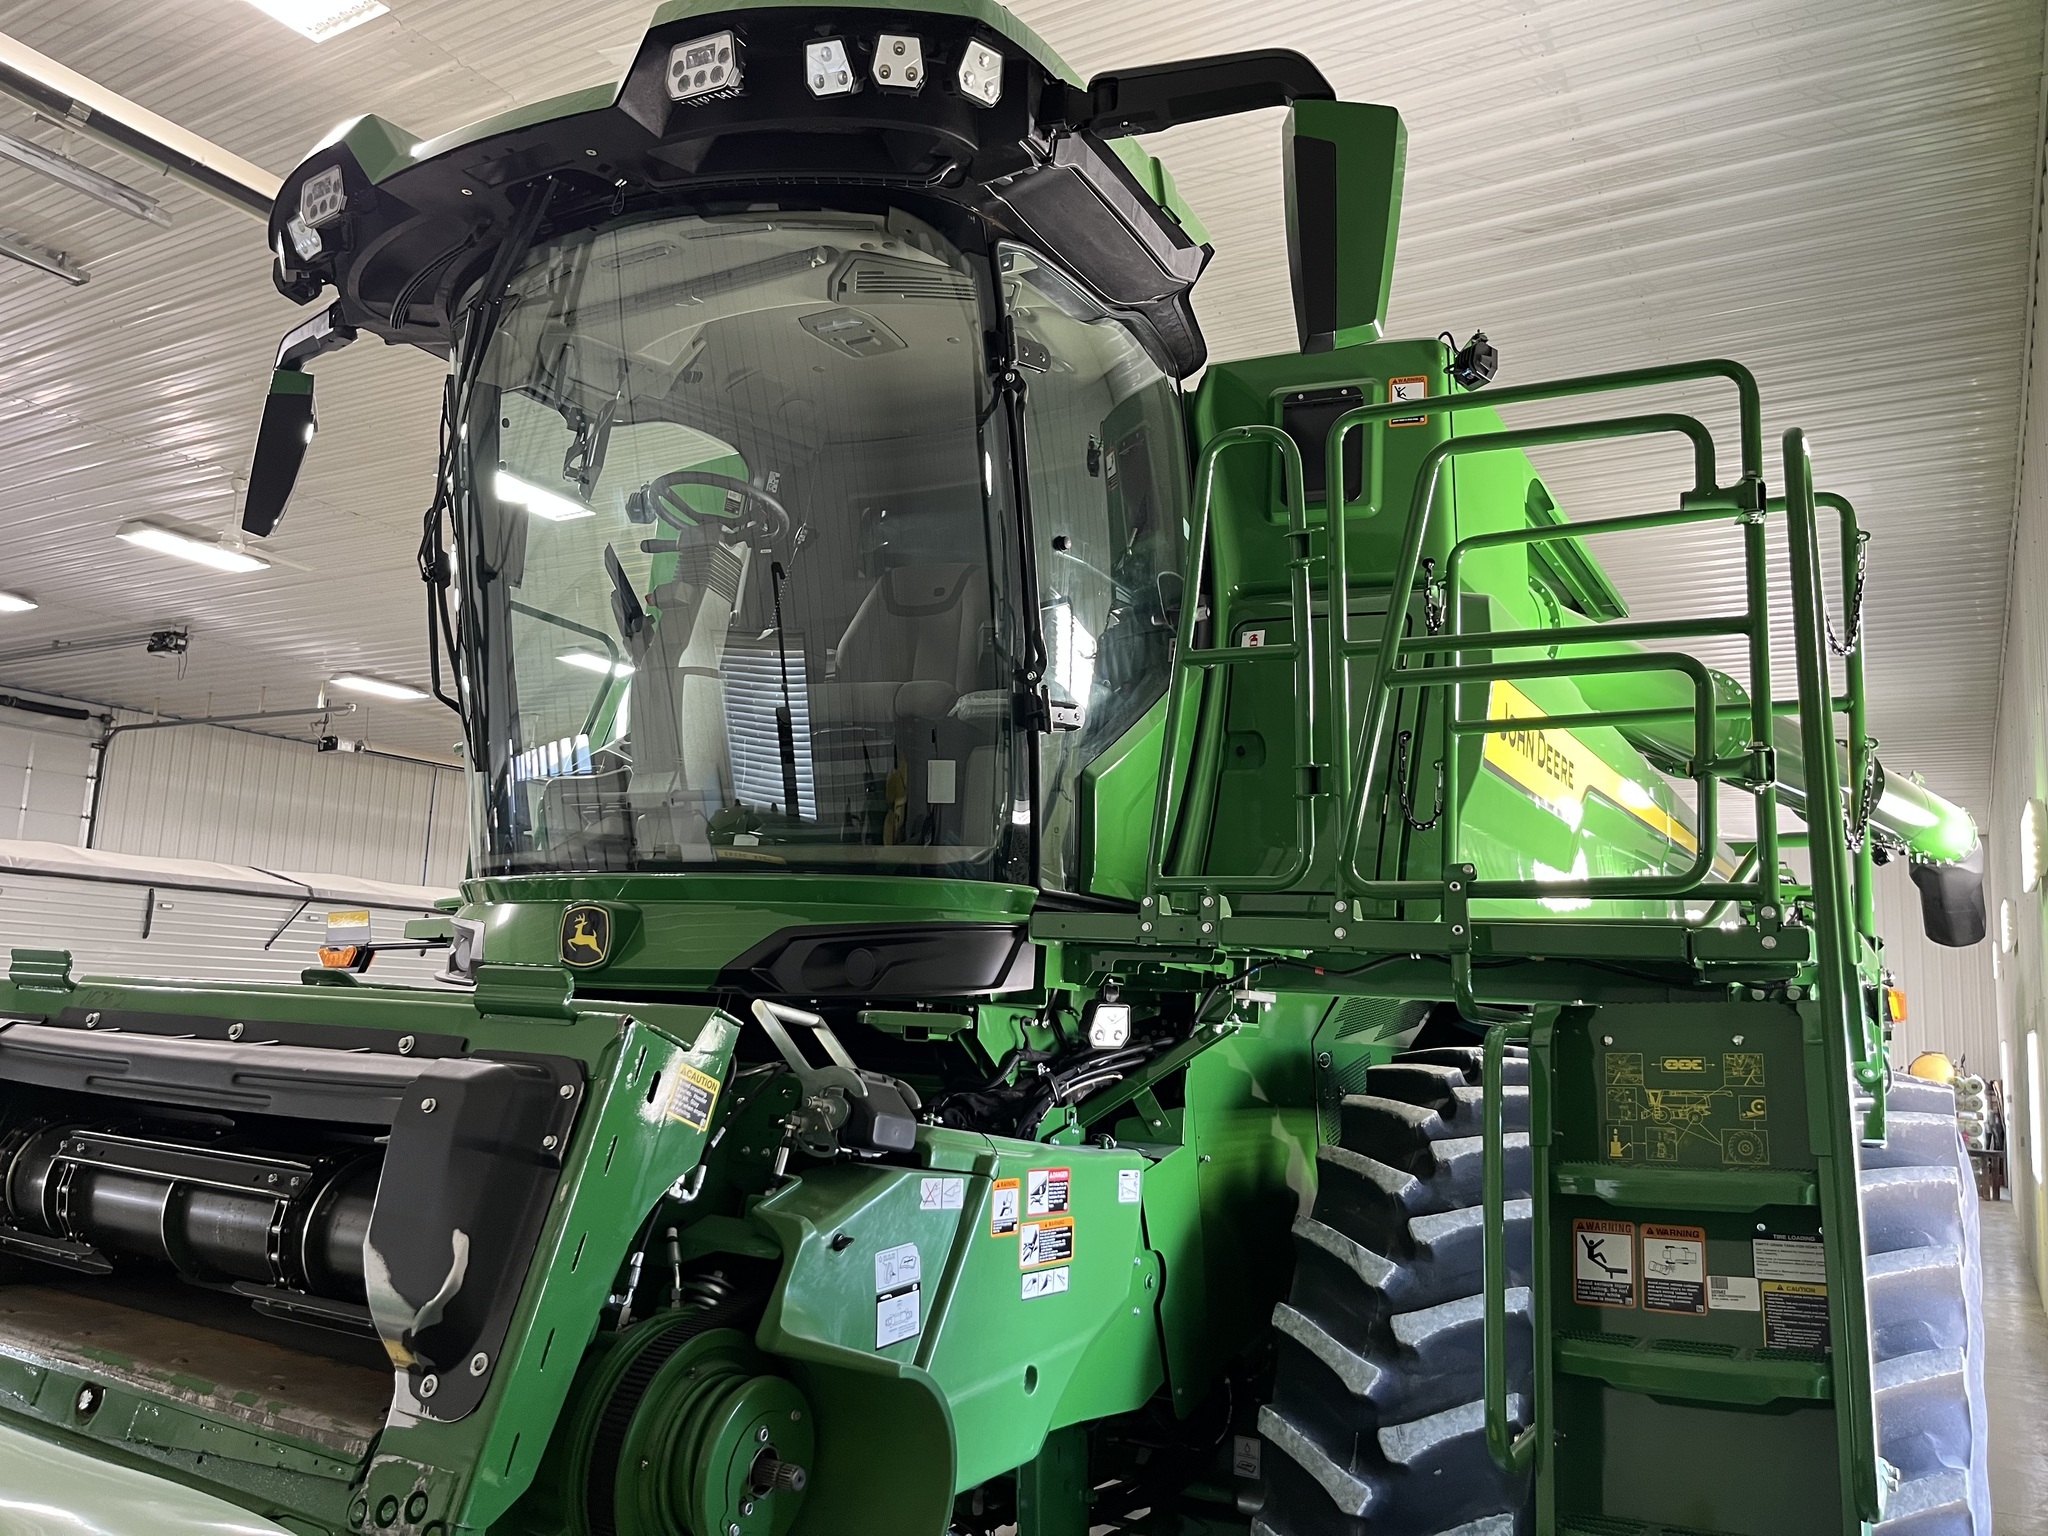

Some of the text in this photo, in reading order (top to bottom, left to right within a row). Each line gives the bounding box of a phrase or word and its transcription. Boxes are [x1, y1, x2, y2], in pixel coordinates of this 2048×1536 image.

[1537, 729, 1574, 790] DEERE
[686, 1069, 718, 1092] CAUTION
[1586, 1222, 1632, 1233] WARNING
[1655, 1228, 1700, 1238] WARNING
